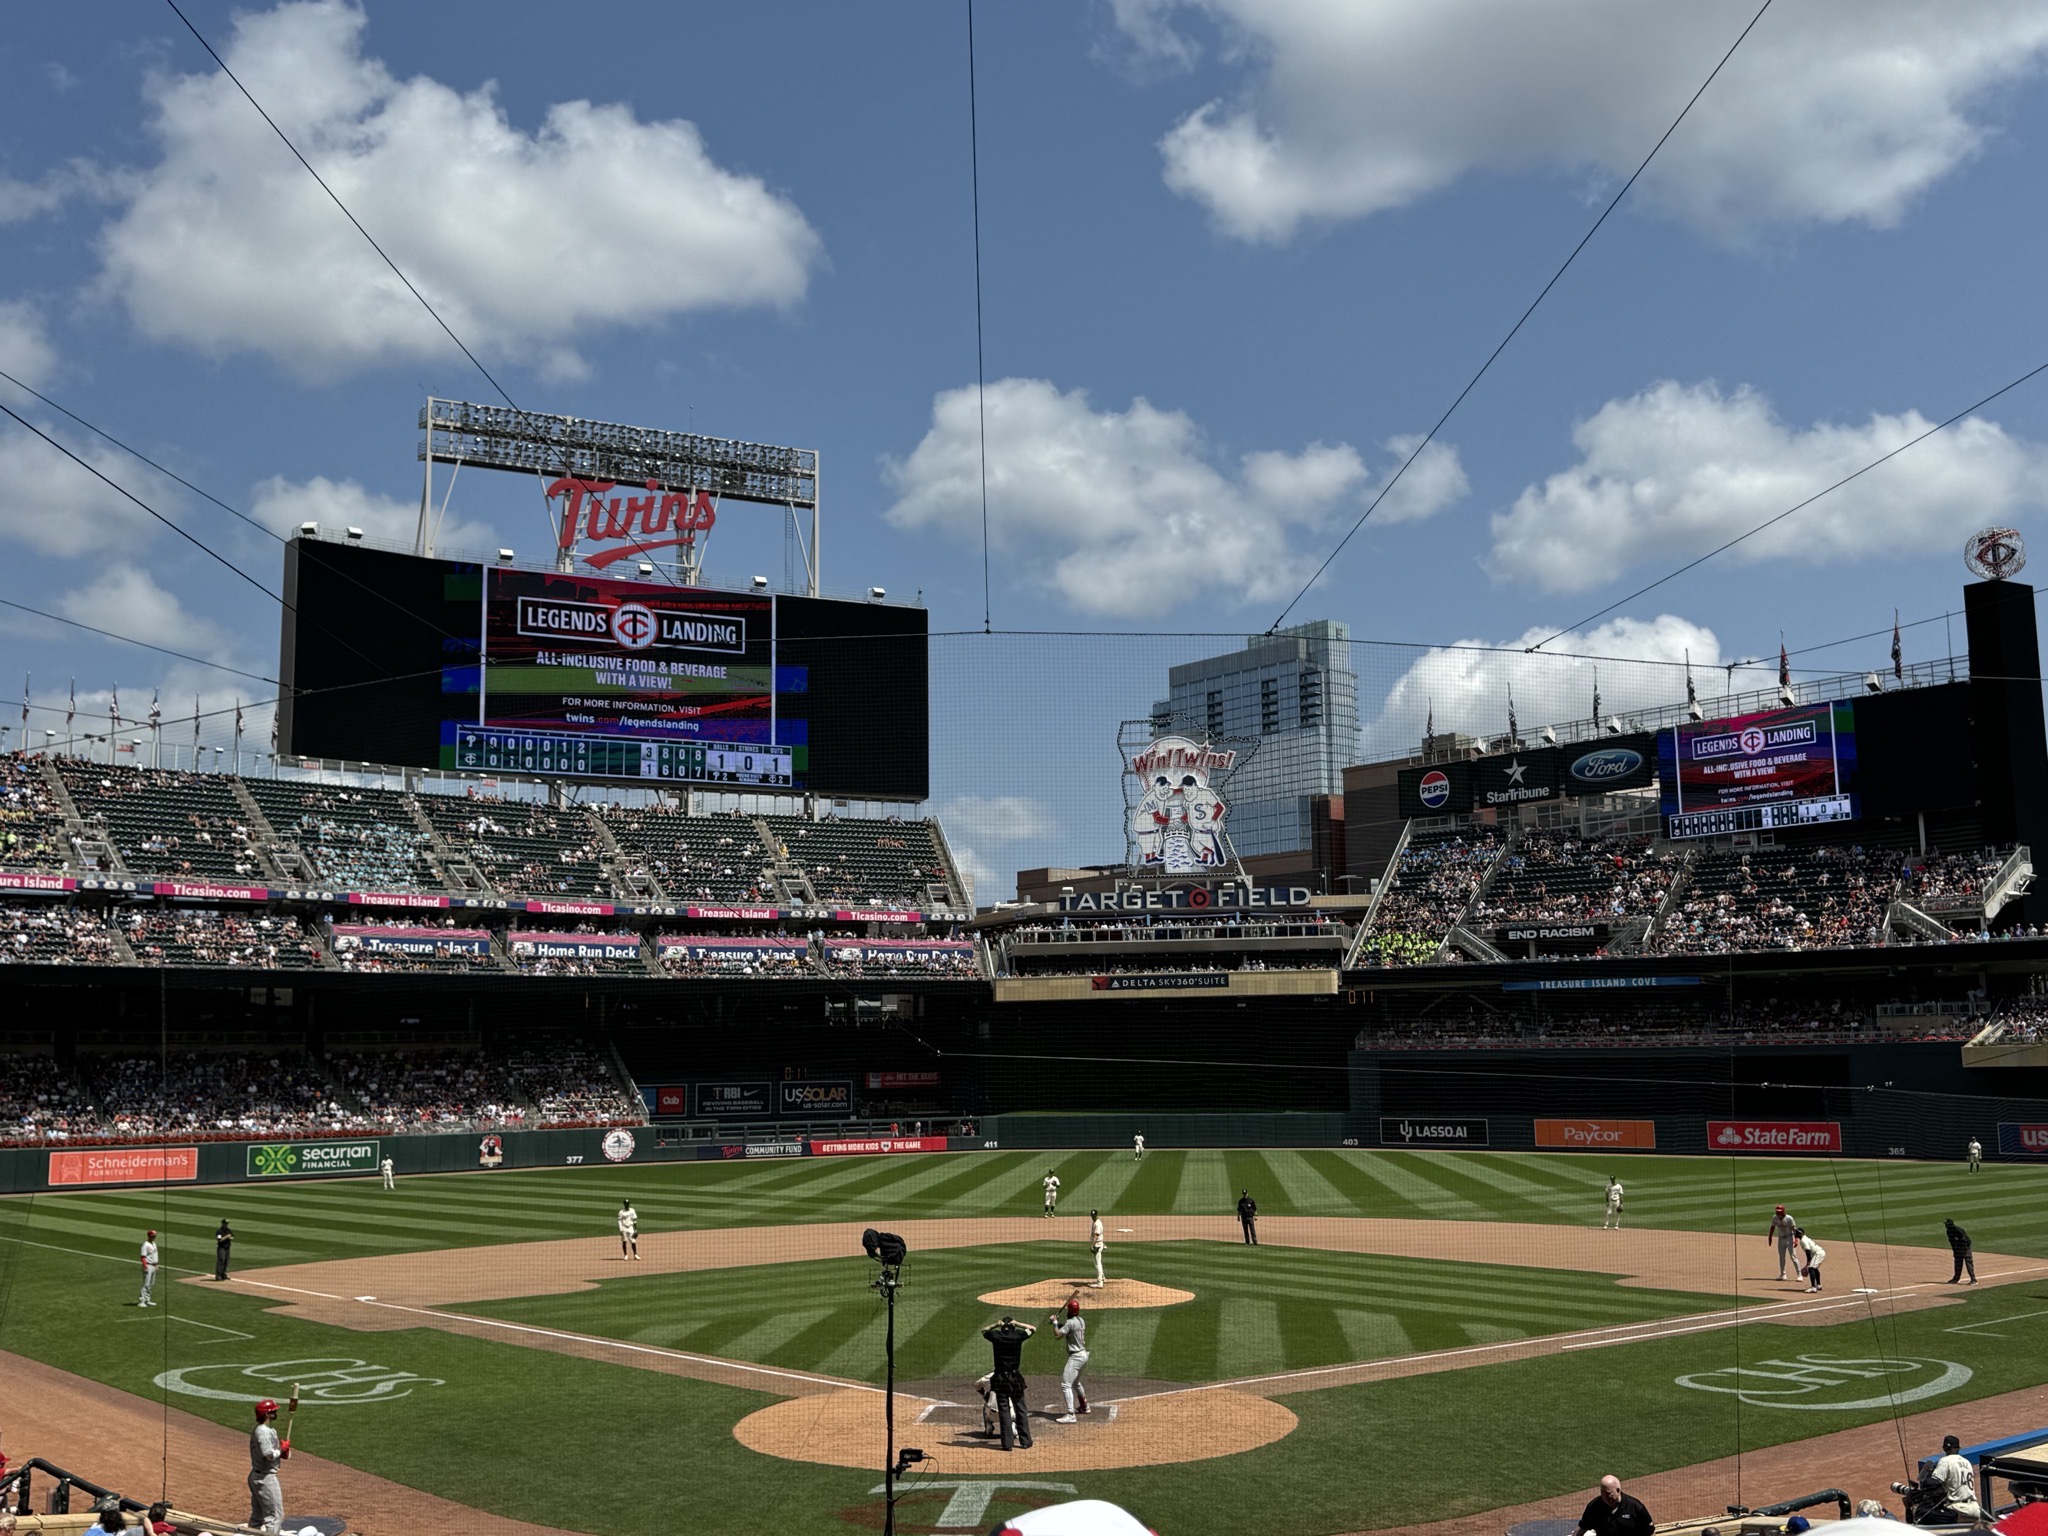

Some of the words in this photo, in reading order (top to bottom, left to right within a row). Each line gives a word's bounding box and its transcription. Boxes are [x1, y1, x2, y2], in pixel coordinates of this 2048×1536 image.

[547, 478, 716, 549] Twins
[527, 606, 607, 632] LEGENDS
[662, 620, 737, 645] LANDING
[625, 658, 657, 673] FOOD
[658, 660, 668, 674] &
[670, 662, 727, 679] BEVERAGE
[595, 671, 627, 686] WITH
[628, 673, 637, 687] A
[641, 674, 672, 689] VIEW!
[562, 697, 581, 706] FOR
[583, 699, 610, 709] MORE
[612, 700, 677, 714] INFORMATION,
[679, 705, 701, 715] VISIT
[1696, 737, 1738, 754] LEGENDS
[1767, 726, 1811, 745] LANDING
[508, 738, 515, 750] 0
[526, 739, 532, 750] 0
[544, 740, 550, 752] 0
[562, 742, 567, 752] 1
[578, 743, 585, 754] 2
[646, 747, 652, 758] 3
[662, 748, 669, 759] 8
[678, 749, 685, 760] 0
[695, 750, 702, 760] 8
[490, 754, 497, 766] 0
[526, 756, 532, 768] 0
[544, 758, 550, 768] 0
[560, 758, 568, 770] 0
[578, 760, 585, 770] 0
[646, 764, 652, 774] 1
[662, 765, 669, 776] 6
[678, 766, 685, 776] 0
[695, 767, 702, 778] 7
[718, 754, 724, 769] 1
[744, 756, 752, 770] 0
[772, 758, 778, 772] 1
[1133, 749, 1173, 773] Win!
[1176, 746, 1236, 769] Twins!
[1584, 755, 1627, 777] Ford
[1749, 758, 1766, 769] FOOD
[1767, 757, 1773, 766] &
[1774, 753, 1807, 765] BEVERAGE
[1734, 768, 1751, 779] WITH
[1751, 768, 1757, 777] A
[1757, 766, 1776, 776] VIEW!
[1421, 784, 1448, 795] PEPSI
[1486, 786, 1550, 804] StarTribune
[1194, 803, 1207, 821] S
[1805, 806, 1810, 816] 1
[1821, 804, 1826, 814] 0
[1838, 802, 1842, 812] 1
[23, 877, 63, 889] Island
[359, 893, 407, 906] Treasure
[409, 895, 440, 907] Island
[1058, 890, 1184, 911] TARGET
[1218, 887, 1312, 907] FIELD
[697, 908, 739, 918] Treasure
[741, 909, 769, 919] Island
[1508, 930, 1537, 940] END
[1539, 927, 1594, 938] RACISM
[538, 944, 575, 957] Home
[578, 945, 602, 957] Run
[606, 946, 636, 958] Deck
[1122, 978, 1155, 987] DELTA
[1539, 979, 1586, 989] TREASURE
[1591, 978, 1626, 988] ISLAND
[1631, 977, 1657, 986] COVE
[724, 1087, 741, 1099] RBI
[662, 1095, 680, 1106] Cub
[1415, 1125, 1467, 1138] LASSO.AI
[1564, 1126, 1623, 1144] Paycor
[745, 1145, 784, 1155] COMMUNITY
[785, 1143, 802, 1153] FUND
[822, 1143, 847, 1152] GETTING
[848, 1143, 864, 1151] MORE
[865, 1142, 879, 1151] KIDS
[893, 1141, 904, 1150] THE
[905, 1141, 921, 1149] GAME
[984, 1140, 998, 1149] 411
[1342, 1138, 1359, 1146] 403
[302, 1144, 371, 1161] securian
[721, 1145, 743, 1157] Twins
[1888, 1147, 1906, 1156] 365
[88, 1154, 188, 1169] Schneiderman's
[302, 1159, 351, 1169] FINANCIAL
[566, 1155, 583, 1164] 377
[88, 1168, 134, 1176] FURNITURE
